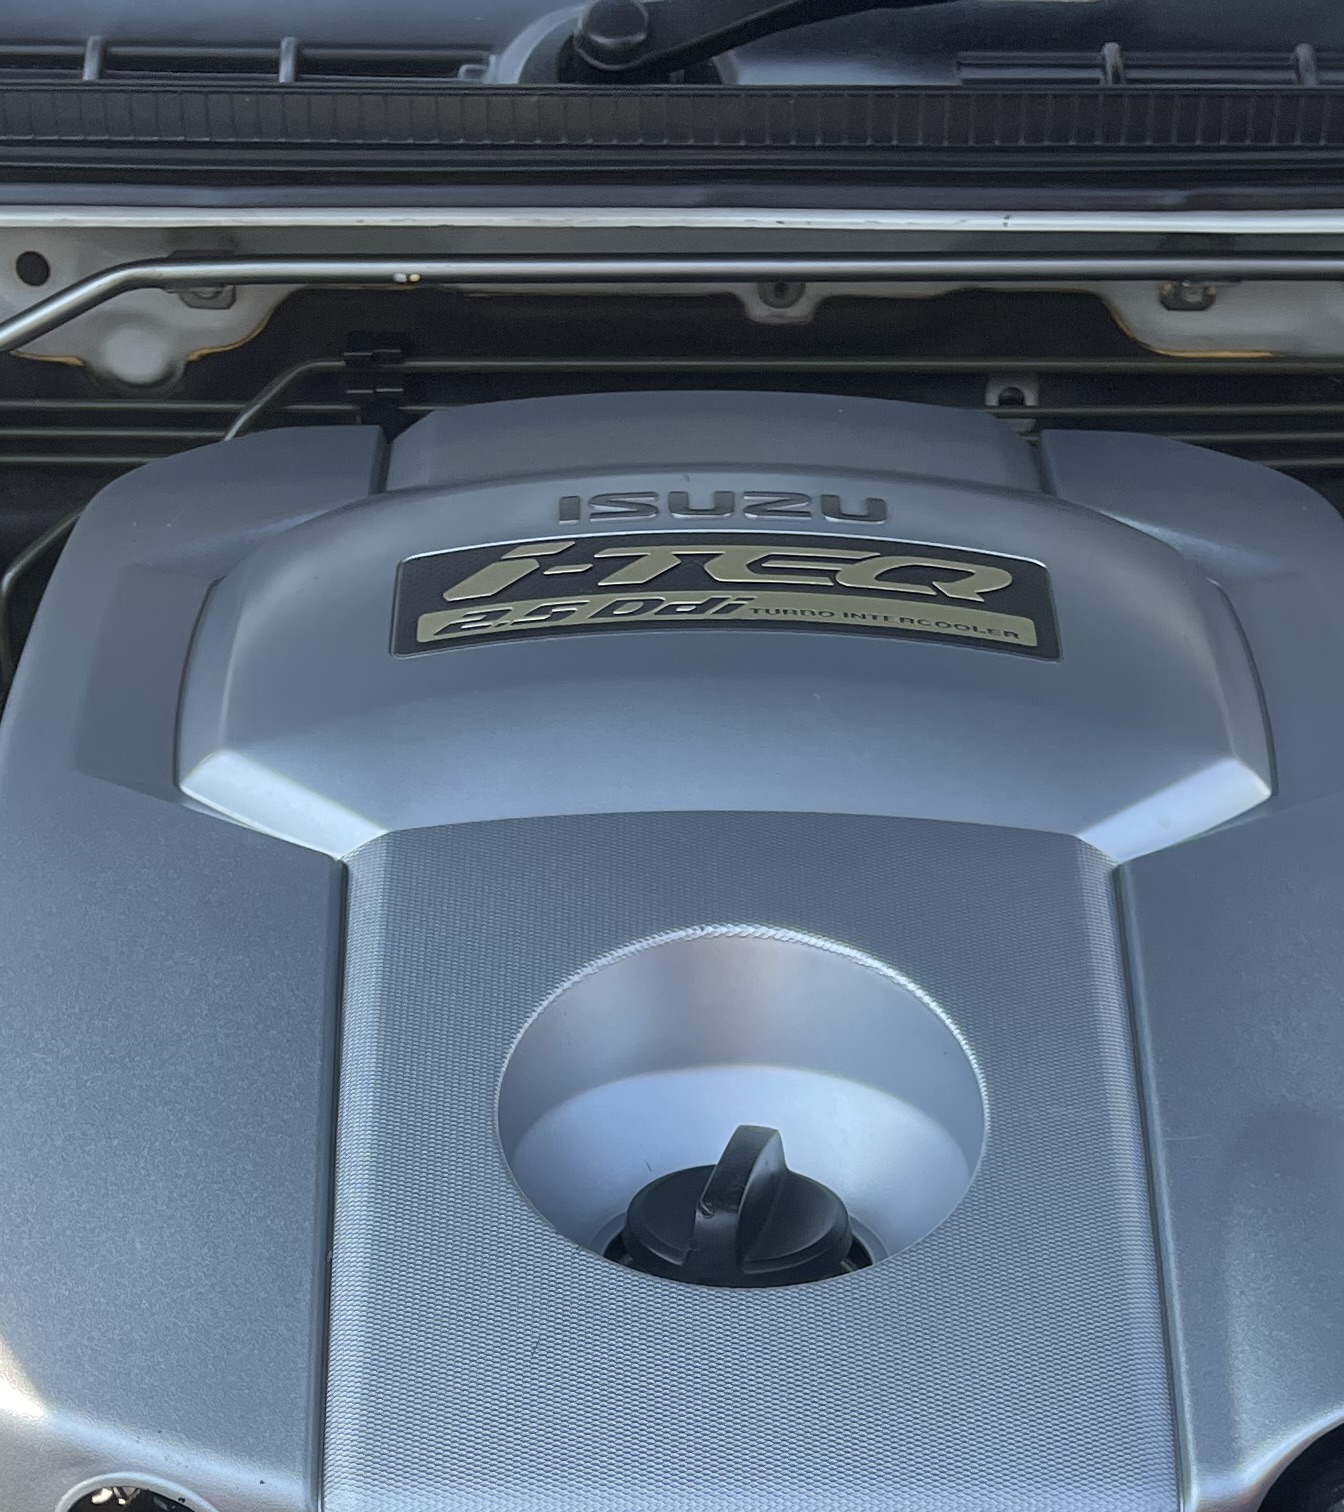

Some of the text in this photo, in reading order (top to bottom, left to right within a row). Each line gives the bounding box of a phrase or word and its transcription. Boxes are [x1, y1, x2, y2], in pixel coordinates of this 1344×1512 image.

[558, 490, 889, 525] ISUZU
[749, 606, 836, 619] TURBO
[842, 611, 1021, 640] INTERCOOLER
